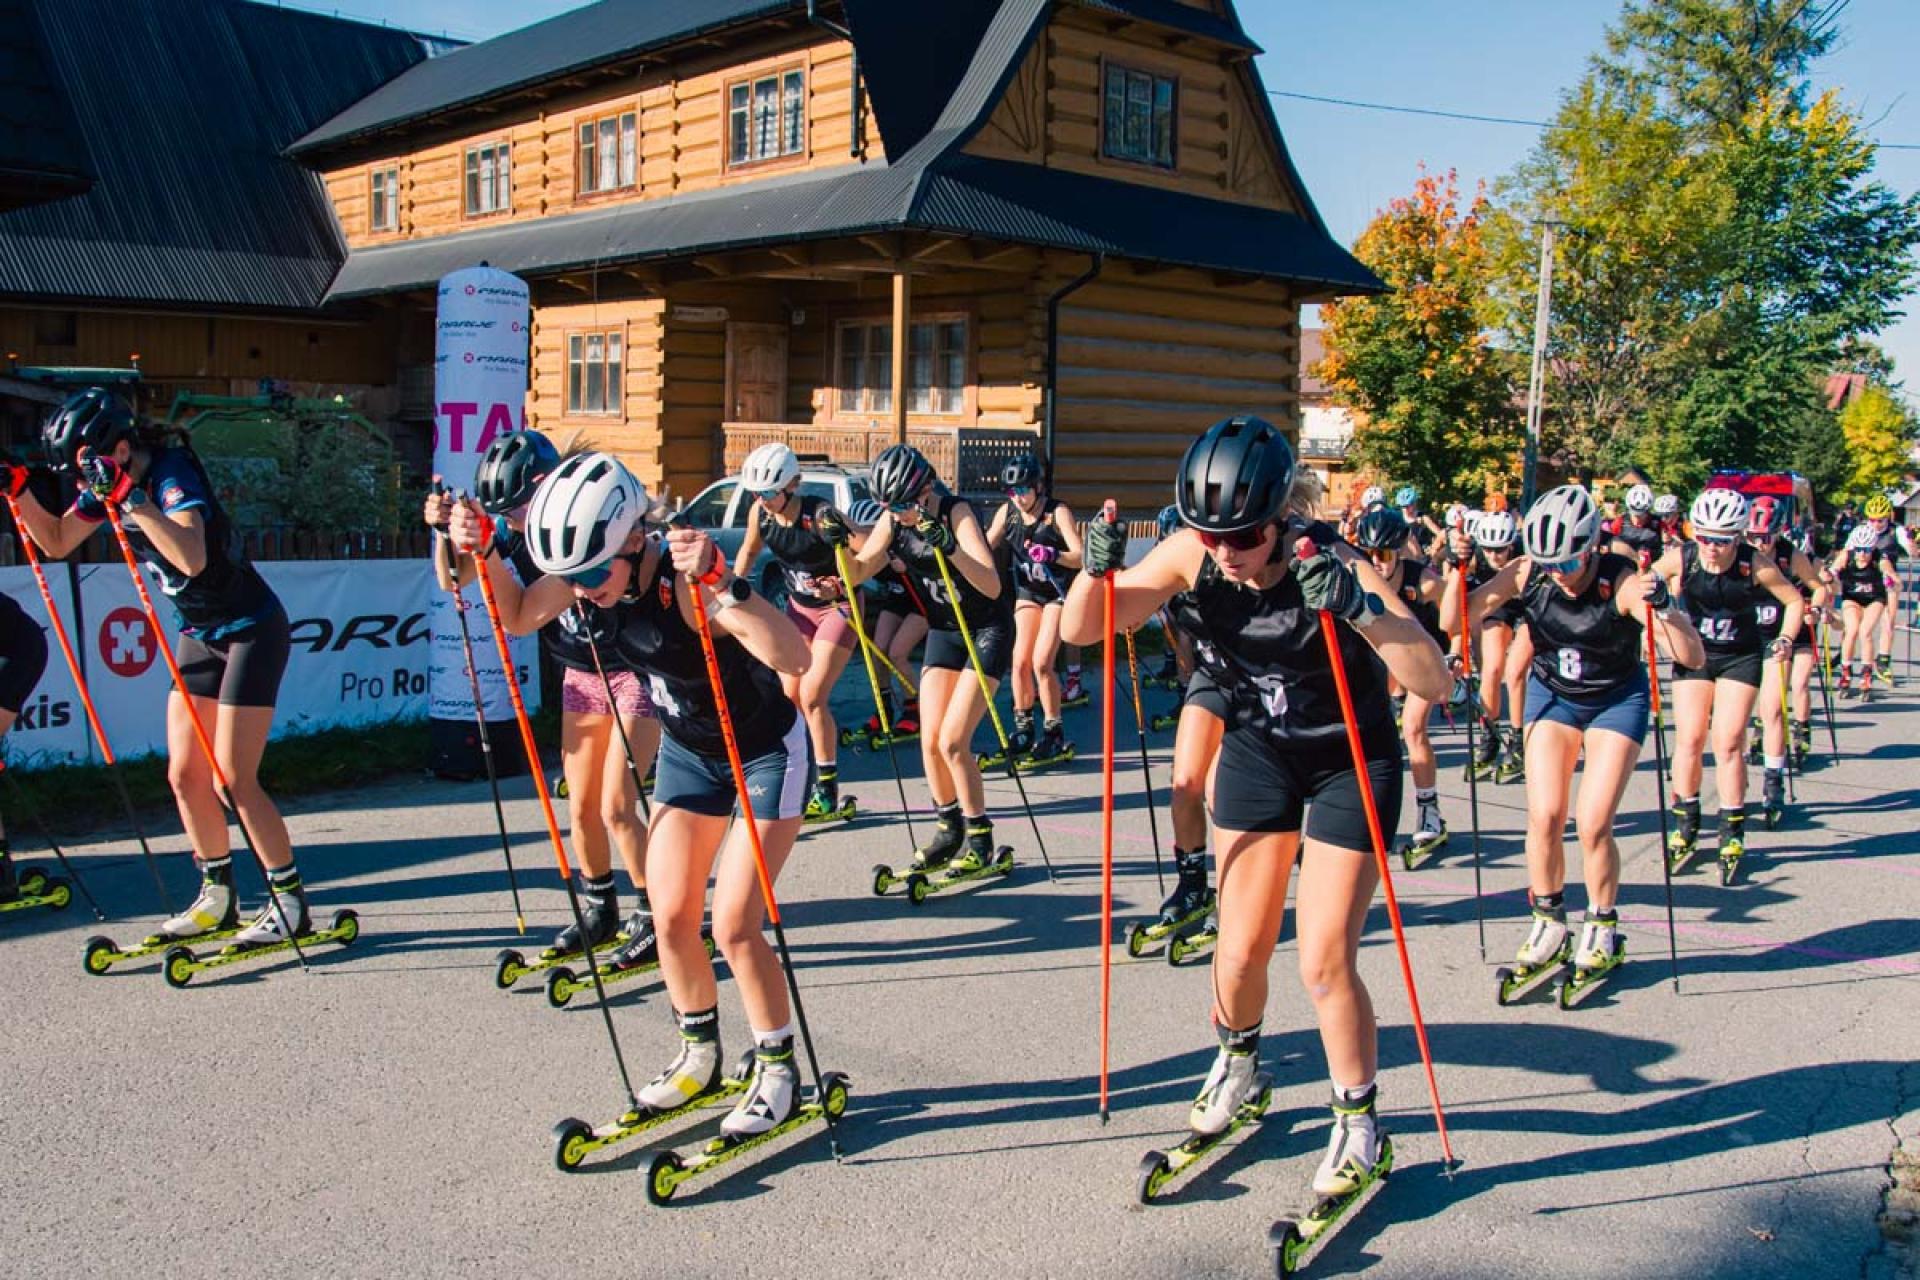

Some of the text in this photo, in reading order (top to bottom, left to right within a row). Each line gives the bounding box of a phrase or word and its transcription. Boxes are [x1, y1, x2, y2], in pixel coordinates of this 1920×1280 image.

[435, 402, 528, 453] TA
[1699, 616, 1736, 641] 42
[1559, 647, 1582, 680] 8
[341, 671, 385, 702] Pro
[13, 694, 71, 732] kis
